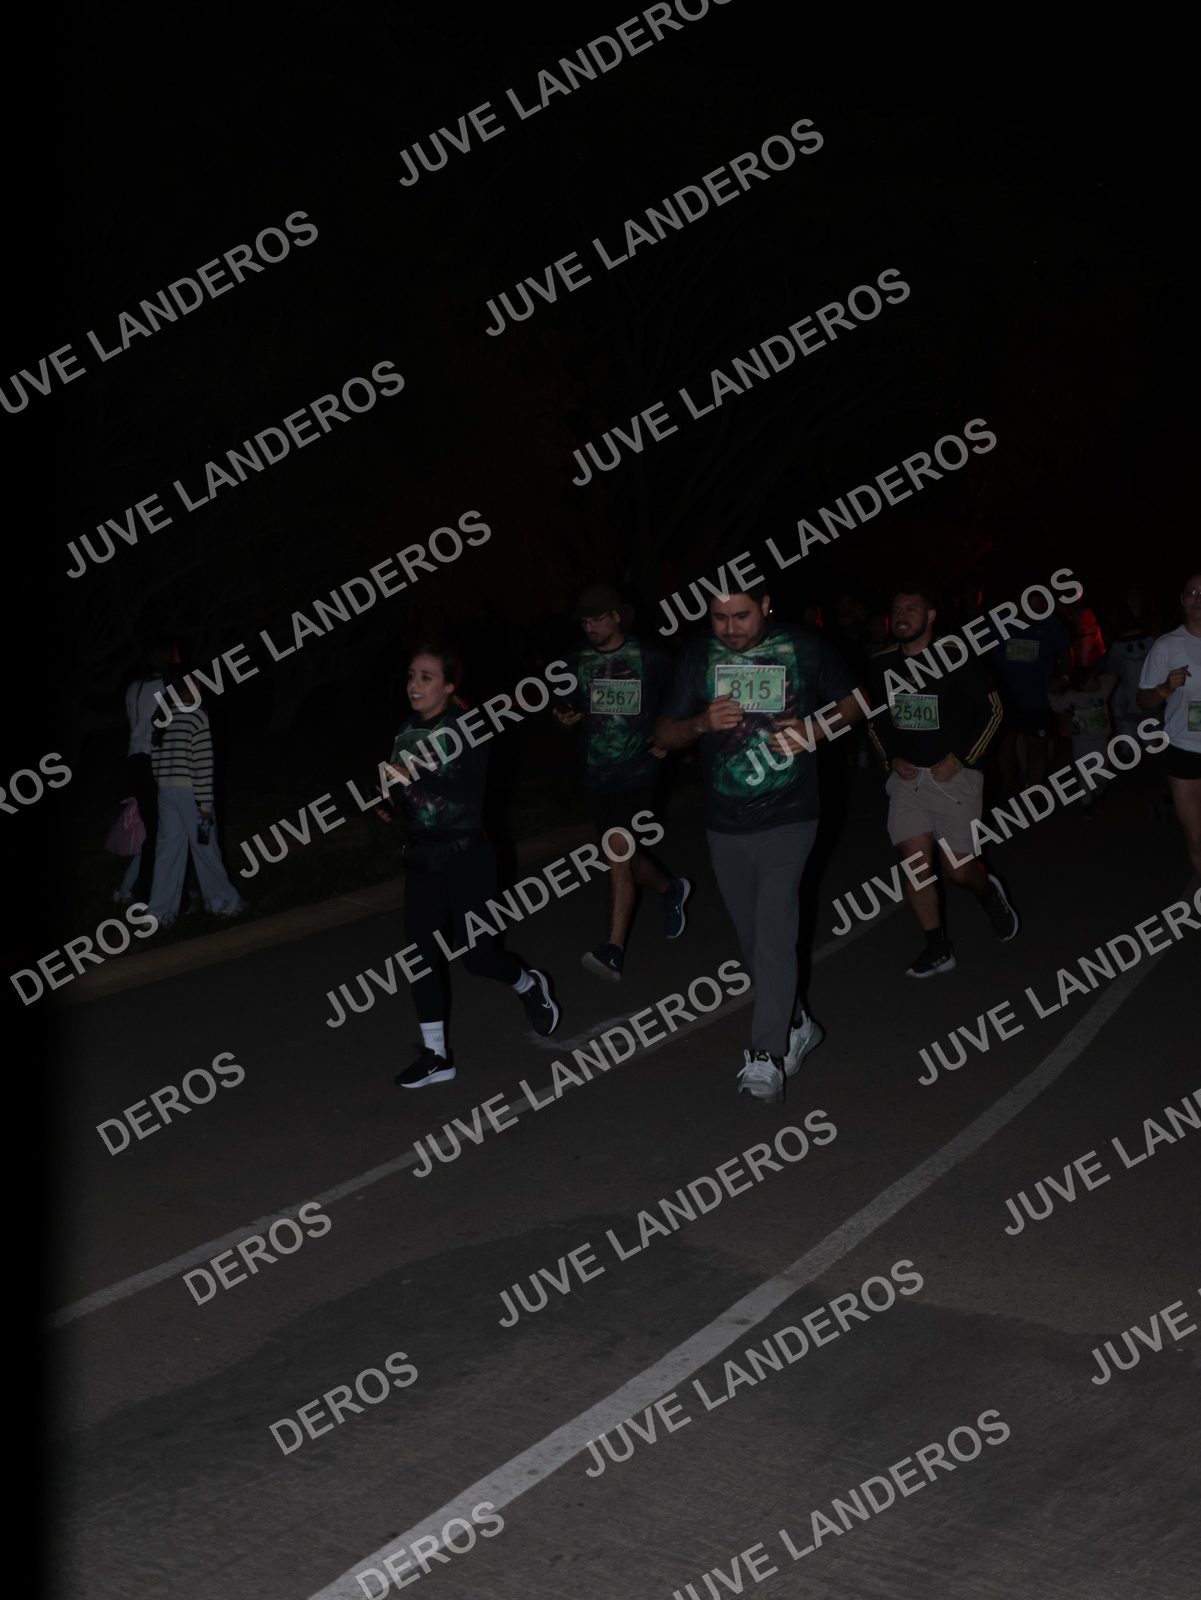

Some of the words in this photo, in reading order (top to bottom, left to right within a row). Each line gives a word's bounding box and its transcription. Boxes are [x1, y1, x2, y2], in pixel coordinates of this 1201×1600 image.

[596, 689, 636, 706] 2567
[730, 679, 772, 700] 815
[894, 704, 933, 721] 2540
